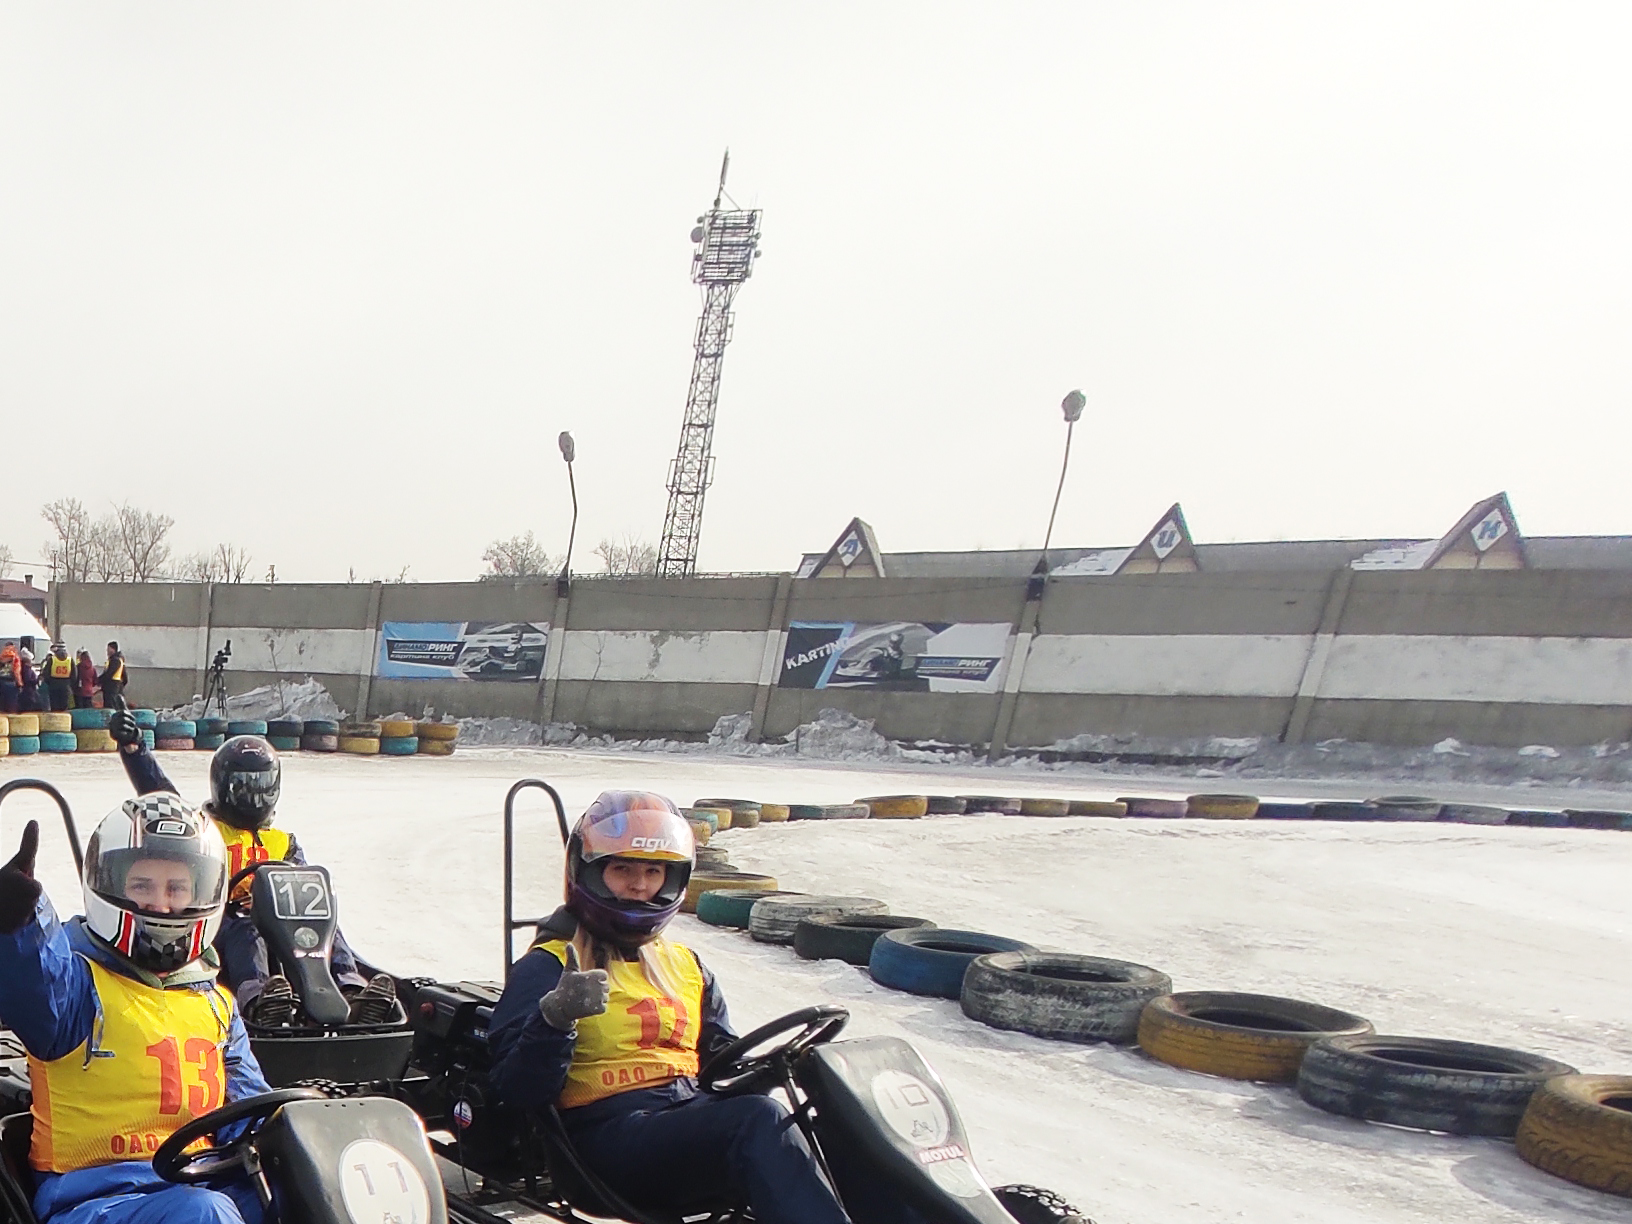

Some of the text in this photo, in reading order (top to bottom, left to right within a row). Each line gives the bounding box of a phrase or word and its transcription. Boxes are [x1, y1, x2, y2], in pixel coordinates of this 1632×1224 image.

[631, 837, 671, 853] agv
[279, 882, 328, 916] 12
[146, 1036, 221, 1118] 13
[919, 1146, 965, 1164] MOTUL
[354, 1161, 409, 1196] 11
